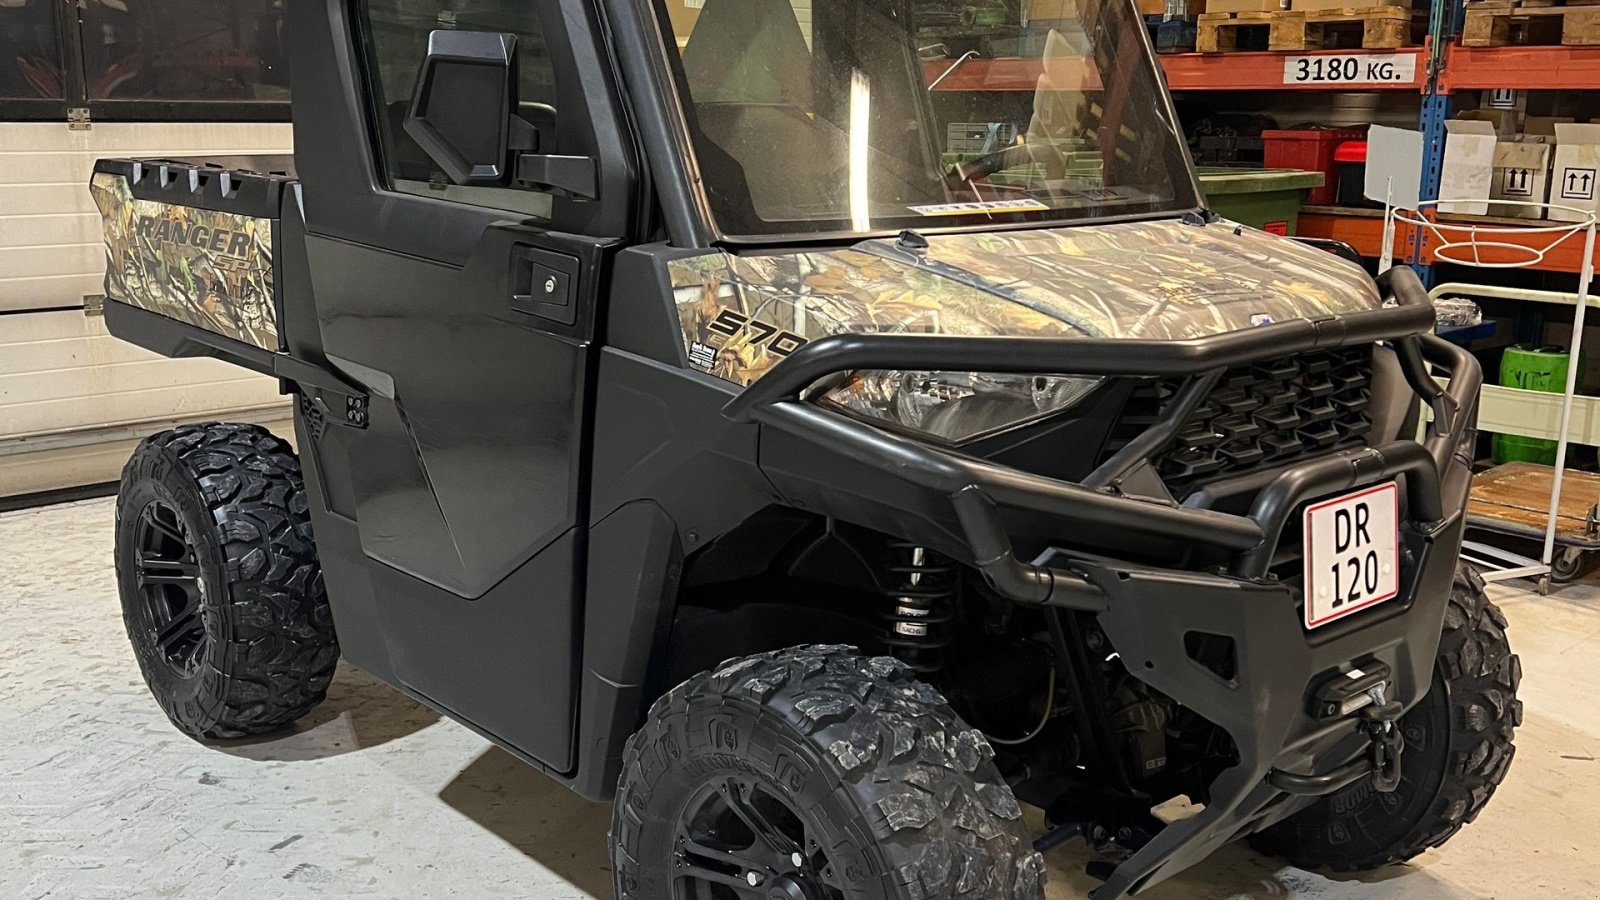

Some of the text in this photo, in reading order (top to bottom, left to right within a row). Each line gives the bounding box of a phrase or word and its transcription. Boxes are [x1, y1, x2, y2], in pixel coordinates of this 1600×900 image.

[1296, 58, 1401, 81] 3180 KG.
[136, 214, 251, 258] RANGER
[213, 254, 252, 272] SP
[707, 307, 809, 358] 570
[1335, 502, 1371, 555] DR
[1332, 550, 1379, 609] 120
